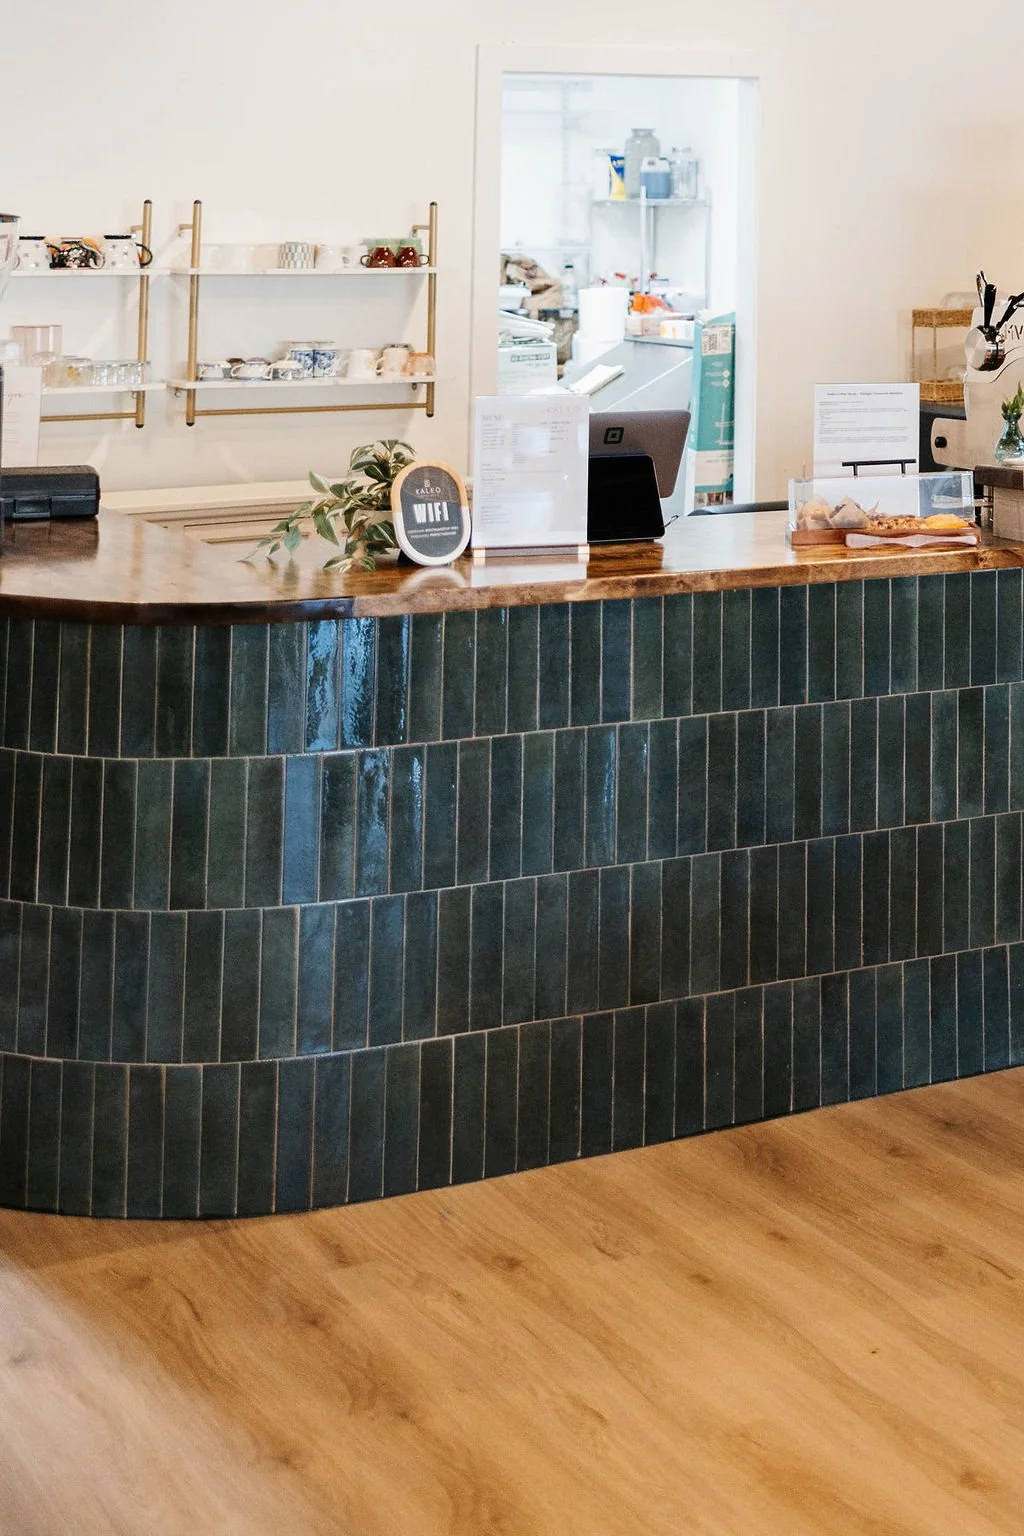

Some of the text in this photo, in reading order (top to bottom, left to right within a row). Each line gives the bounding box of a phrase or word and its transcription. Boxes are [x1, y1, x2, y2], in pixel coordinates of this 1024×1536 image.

[481, 415, 505, 423] MENU
[416, 486, 441, 495] KALEO
[413, 501, 449, 524] WIFI
